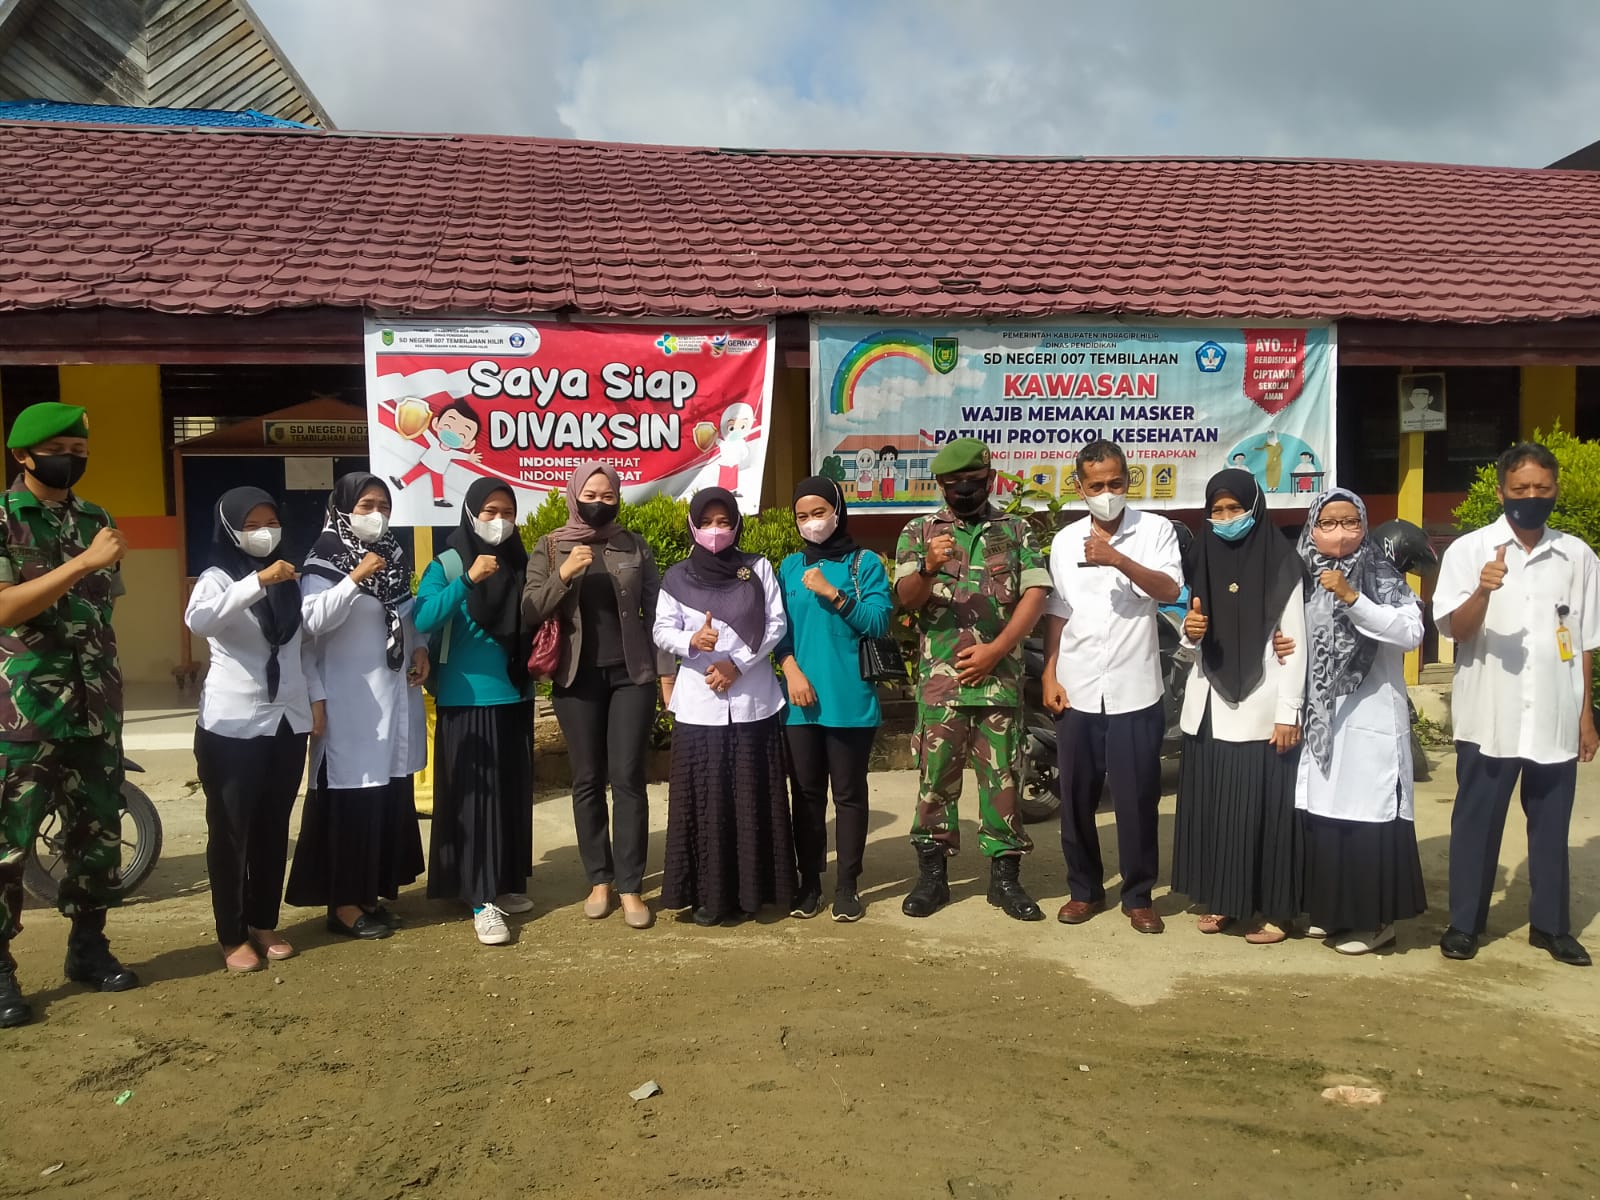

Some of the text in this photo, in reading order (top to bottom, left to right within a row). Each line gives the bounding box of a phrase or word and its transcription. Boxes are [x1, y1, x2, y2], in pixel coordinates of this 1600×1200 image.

[983, 353, 1179, 365] SD NEGERI 007 TEMBILAHAN
[1254, 356, 1296, 364] BERDISIPLIN
[1253, 369, 1295, 379] CIPTAKAN
[468, 361, 697, 408] Saya Siap
[1003, 373, 1158, 399] KAWASAN
[1258, 382, 1288, 390] SEKOLAH
[962, 405, 1195, 422] WAJIB MEMAKAI MASKER
[289, 425, 369, 434] SD NEGERI 007
[490, 410, 681, 450] DIVAKSIN
[291, 434, 344, 442] TEMBILAHAN
[934, 429, 1002, 445] PATUHI
[1112, 428, 1218, 443] KESEHATAN
[1013, 450, 1037, 460] DIRI
[1040, 450, 1078, 460] DENGA
[1137, 449, 1197, 459] TERAPKAN
[519, 471, 572, 481] INDONE
